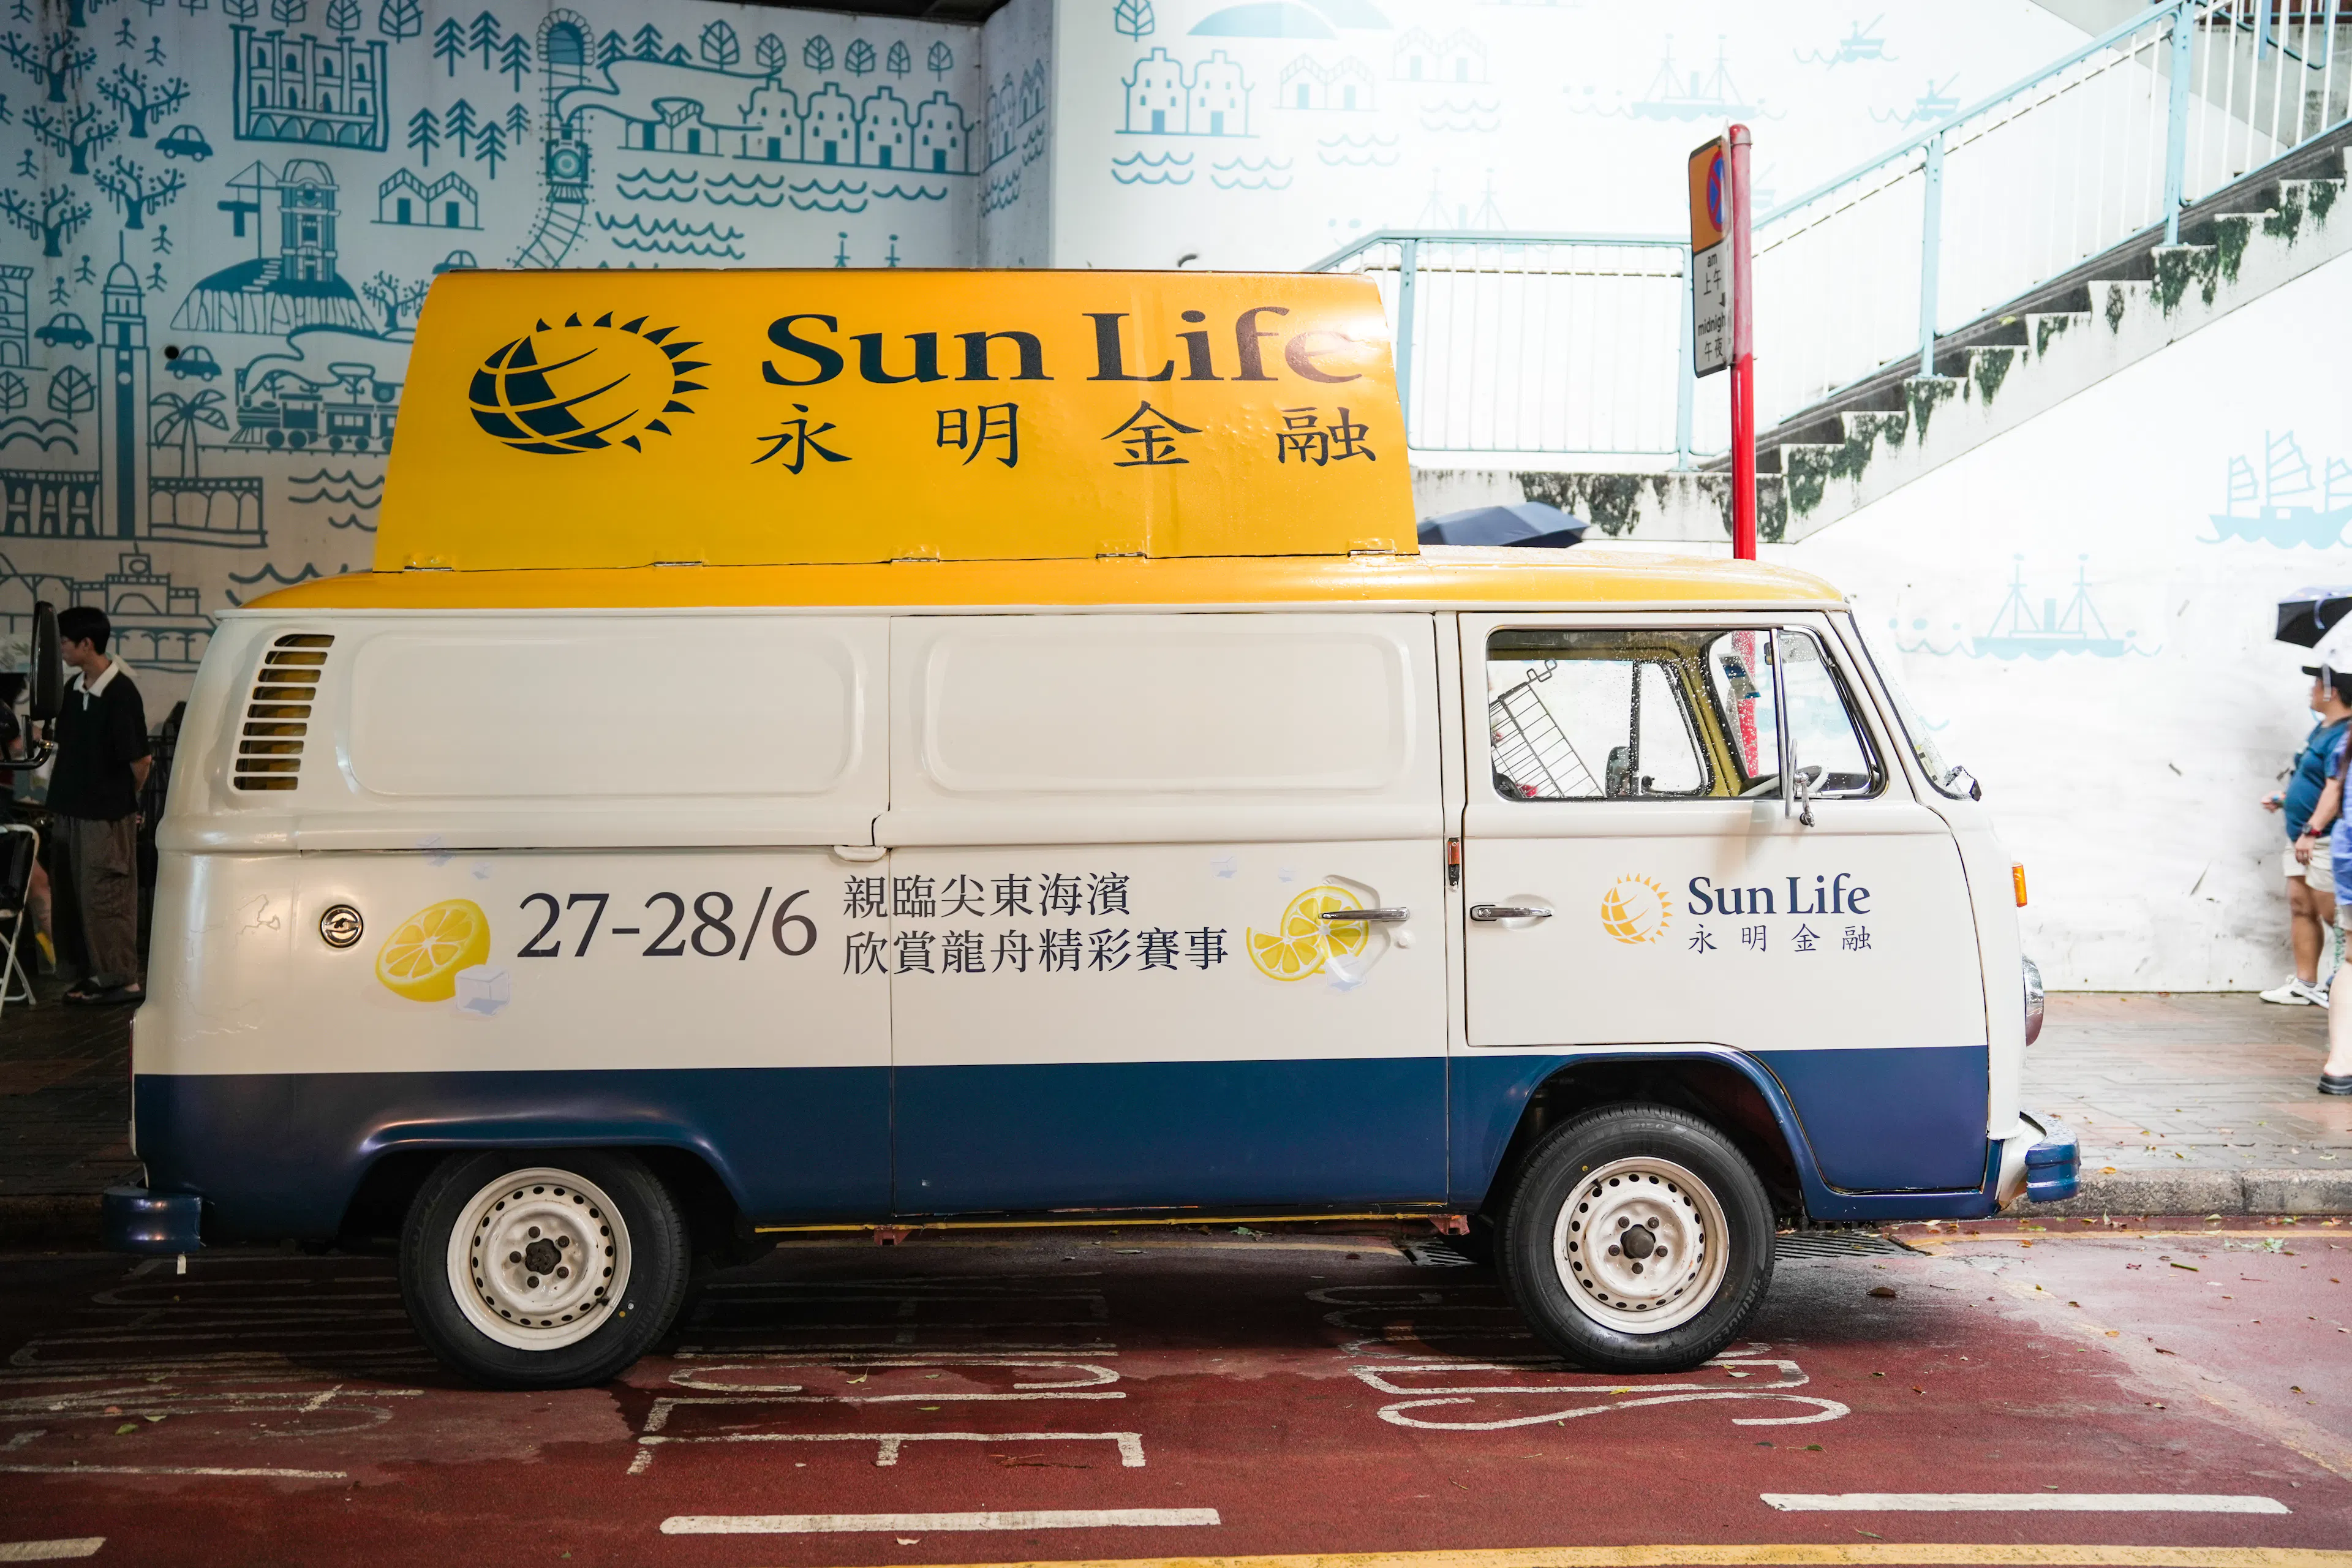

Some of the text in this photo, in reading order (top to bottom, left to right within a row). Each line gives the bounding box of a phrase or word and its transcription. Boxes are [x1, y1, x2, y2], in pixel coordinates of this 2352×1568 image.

[1703, 268, 1722, 295] 上午
[1707, 252, 1718, 268] am
[762, 306, 1364, 386] Sun Life
[1704, 336, 1723, 362] 午夜
[750, 401, 1376, 475] 永明金融
[843, 872, 1130, 919] 親臨尖東海濱
[1688, 872, 1871, 916] Sun Life
[517, 886, 817, 961] 27-28/6
[1688, 923, 1872, 954] 永明金融
[843, 927, 1228, 975] 欣賞龍舟精彩賽事
